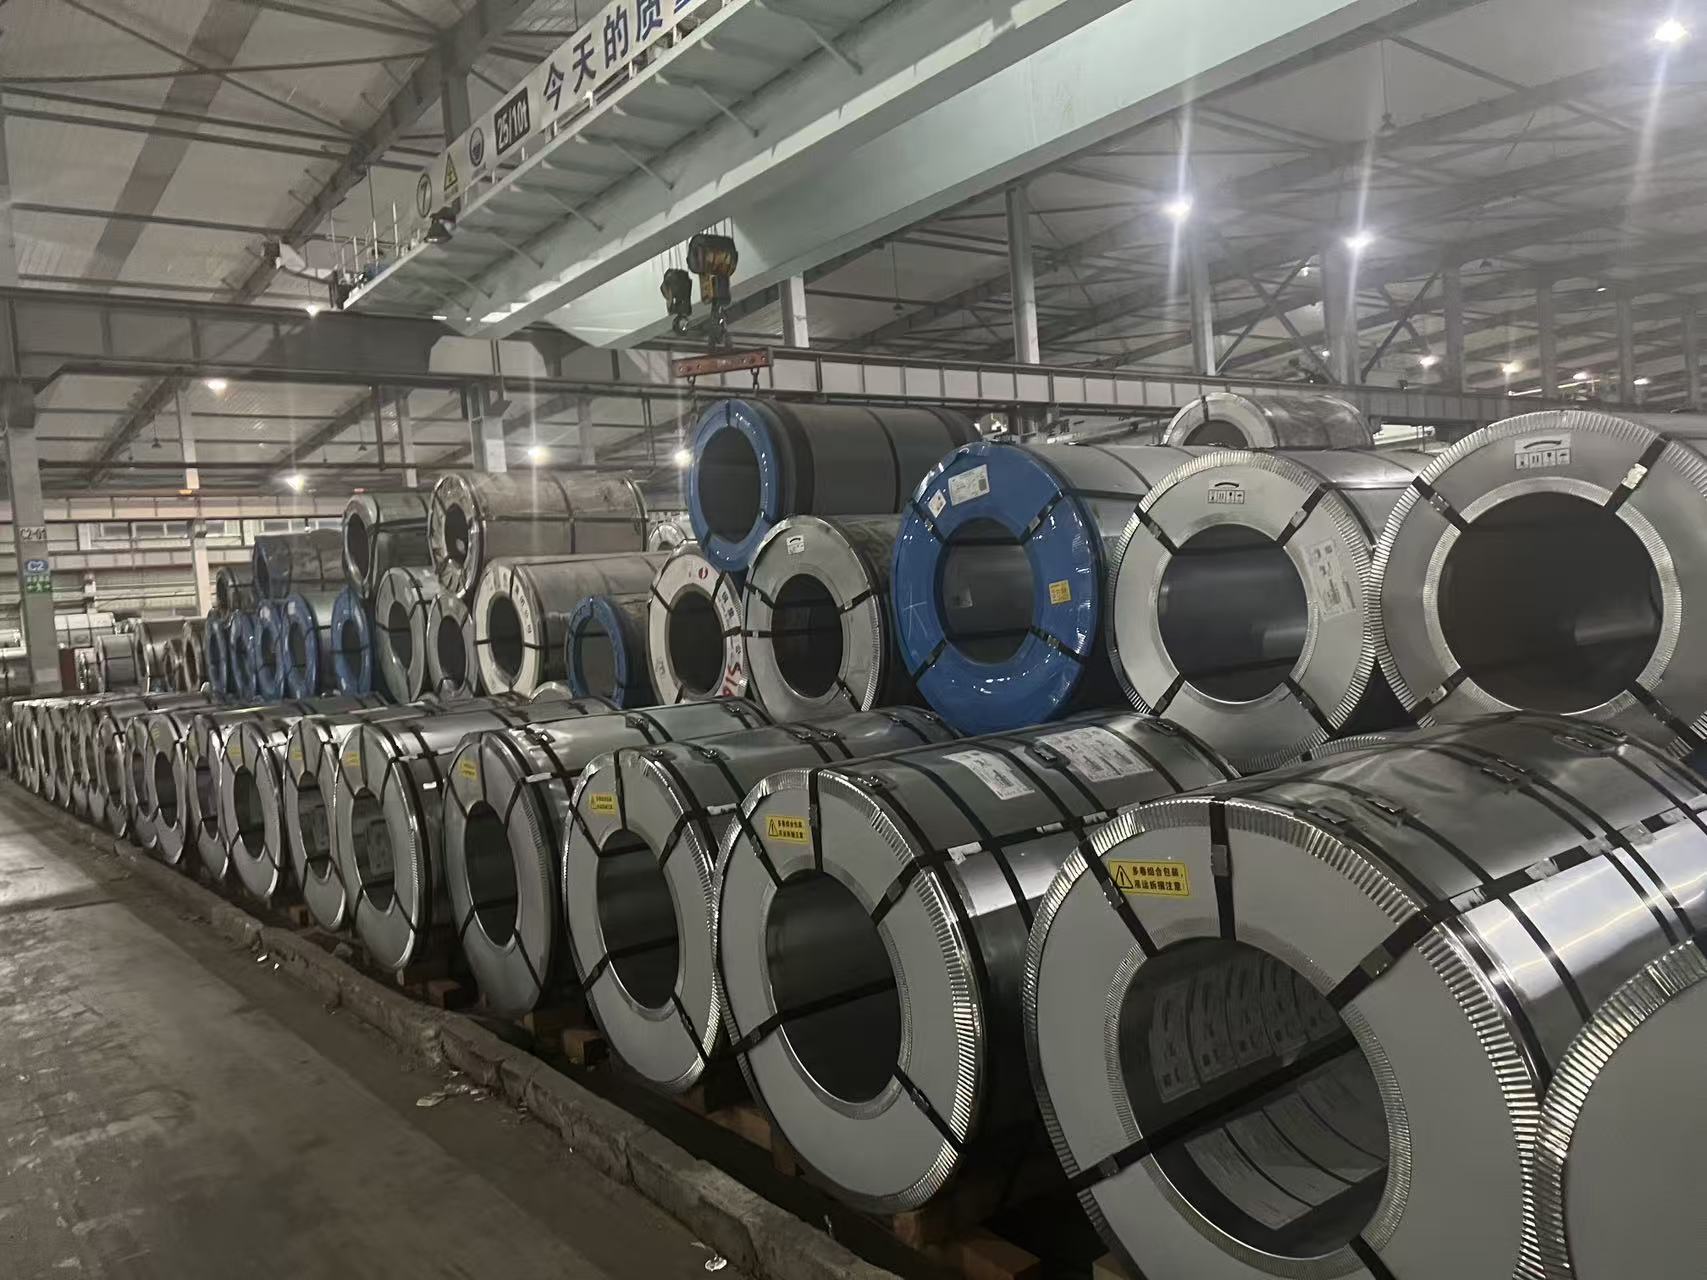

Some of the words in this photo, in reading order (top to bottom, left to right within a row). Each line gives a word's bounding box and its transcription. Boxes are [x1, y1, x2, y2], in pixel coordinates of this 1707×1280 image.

[543, 0, 690, 111] 今天的质
[27, 560, 44, 571] C2
